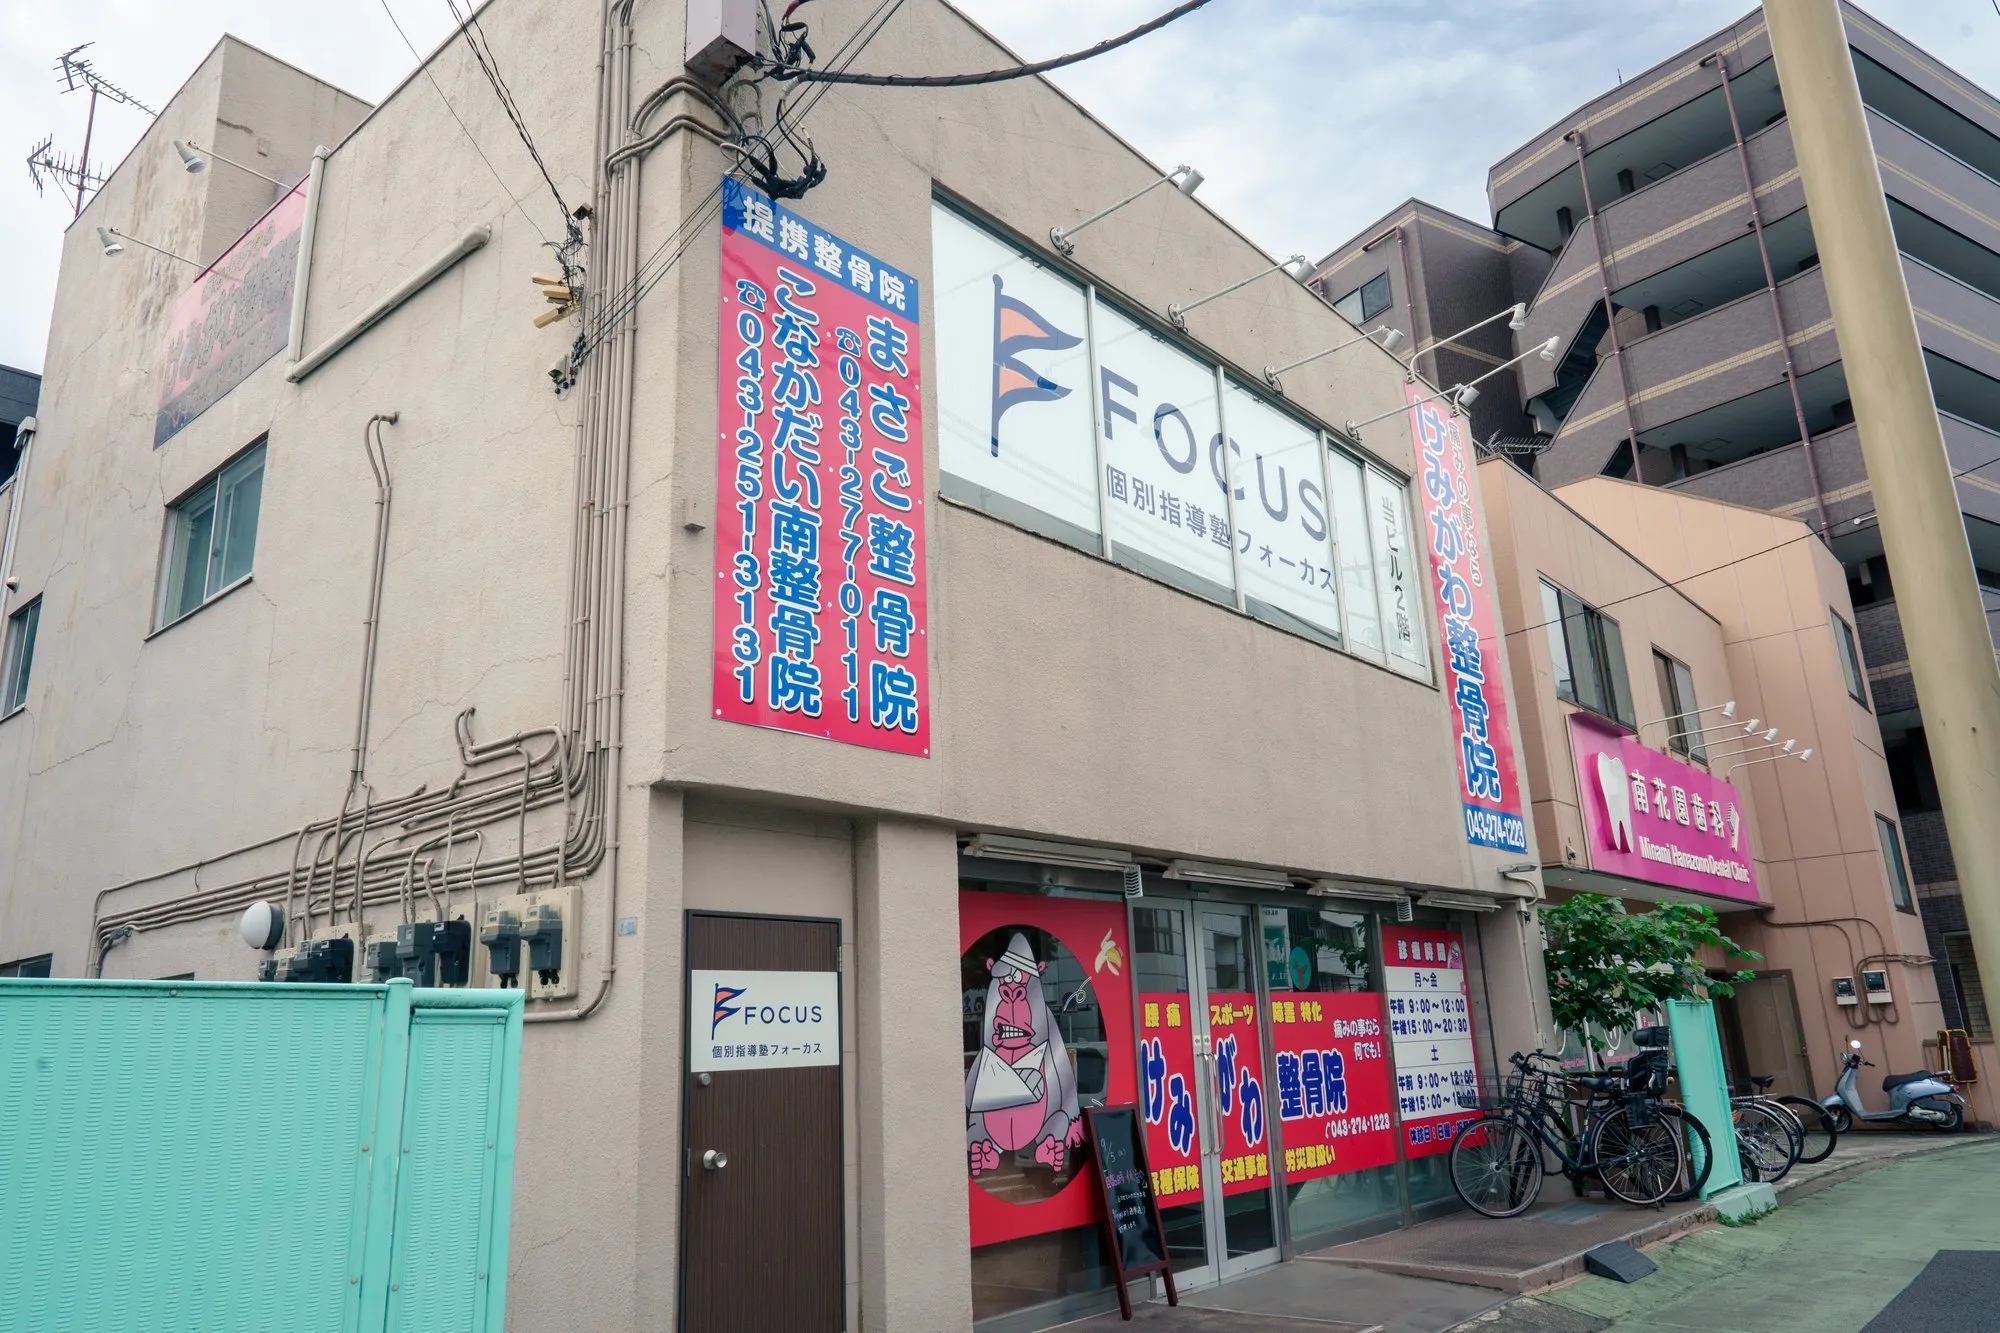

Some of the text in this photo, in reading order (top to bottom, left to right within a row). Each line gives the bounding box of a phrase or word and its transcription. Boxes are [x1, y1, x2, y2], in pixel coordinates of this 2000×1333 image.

[743, 195, 907, 312] 提携整骨院
[1100, 366, 1327, 541] FOCUS
[733, 310, 766, 703] 043-251-3131
[769, 264, 824, 718] こなかだい南整骨院
[866, 314, 919, 736] まさご整骨院
[837, 354, 863, 723] 043-277-0111
[1107, 464, 1336, 595] 個別指導塾フォーカス
[1414, 395, 1502, 802] けみがわ整骨院
[1467, 809, 1524, 848] 043-274-1223
[1630, 769, 1726, 838] 南花園歯科
[1639, 836, 1750, 883] Minami Hanazono Dental Clinic
[744, 1006, 822, 1025] FOCUS
[1210, 1002, 1254, 1026] スポーツ
[1300, 1001, 1323, 1022] 特化
[1333, 1018, 1381, 1039] 痛みの事なら
[712, 1043, 822, 1058] 個別指導塾フォーカス
[1431, 1044, 1439, 1061] 土
[1221, 1152, 1269, 1185] 交通事故
[1285, 1144, 1336, 1173] 労災取扱い
